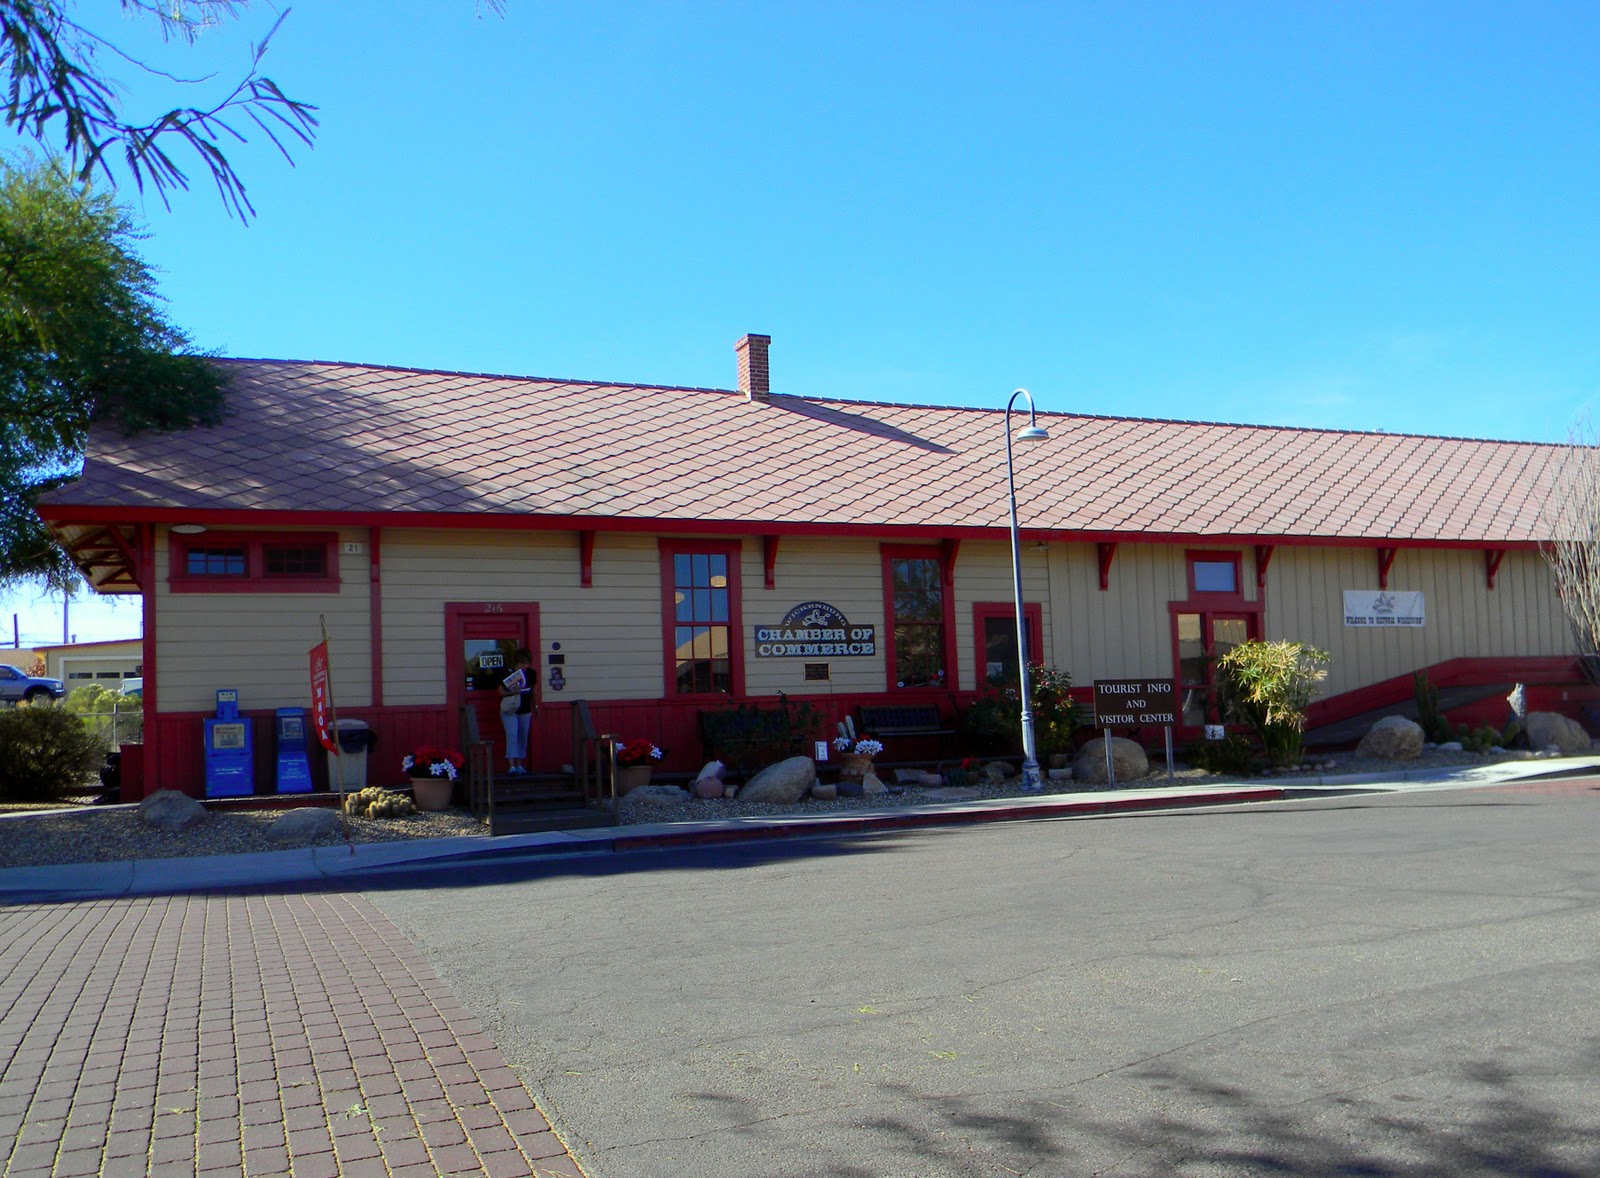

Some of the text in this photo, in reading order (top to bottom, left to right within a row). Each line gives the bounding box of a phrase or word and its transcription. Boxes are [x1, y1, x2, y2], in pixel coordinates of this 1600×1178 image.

[785, 603, 846, 626] WICKENBURG
[758, 629, 873, 641] CHAMBER OF
[759, 643, 874, 656] COMMERCE
[481, 656, 502, 667] OPEN
[1099, 684, 1171, 693] TOURIST INFO
[1126, 700, 1146, 708] AND
[1100, 714, 1174, 723] VISITOR CENTER
